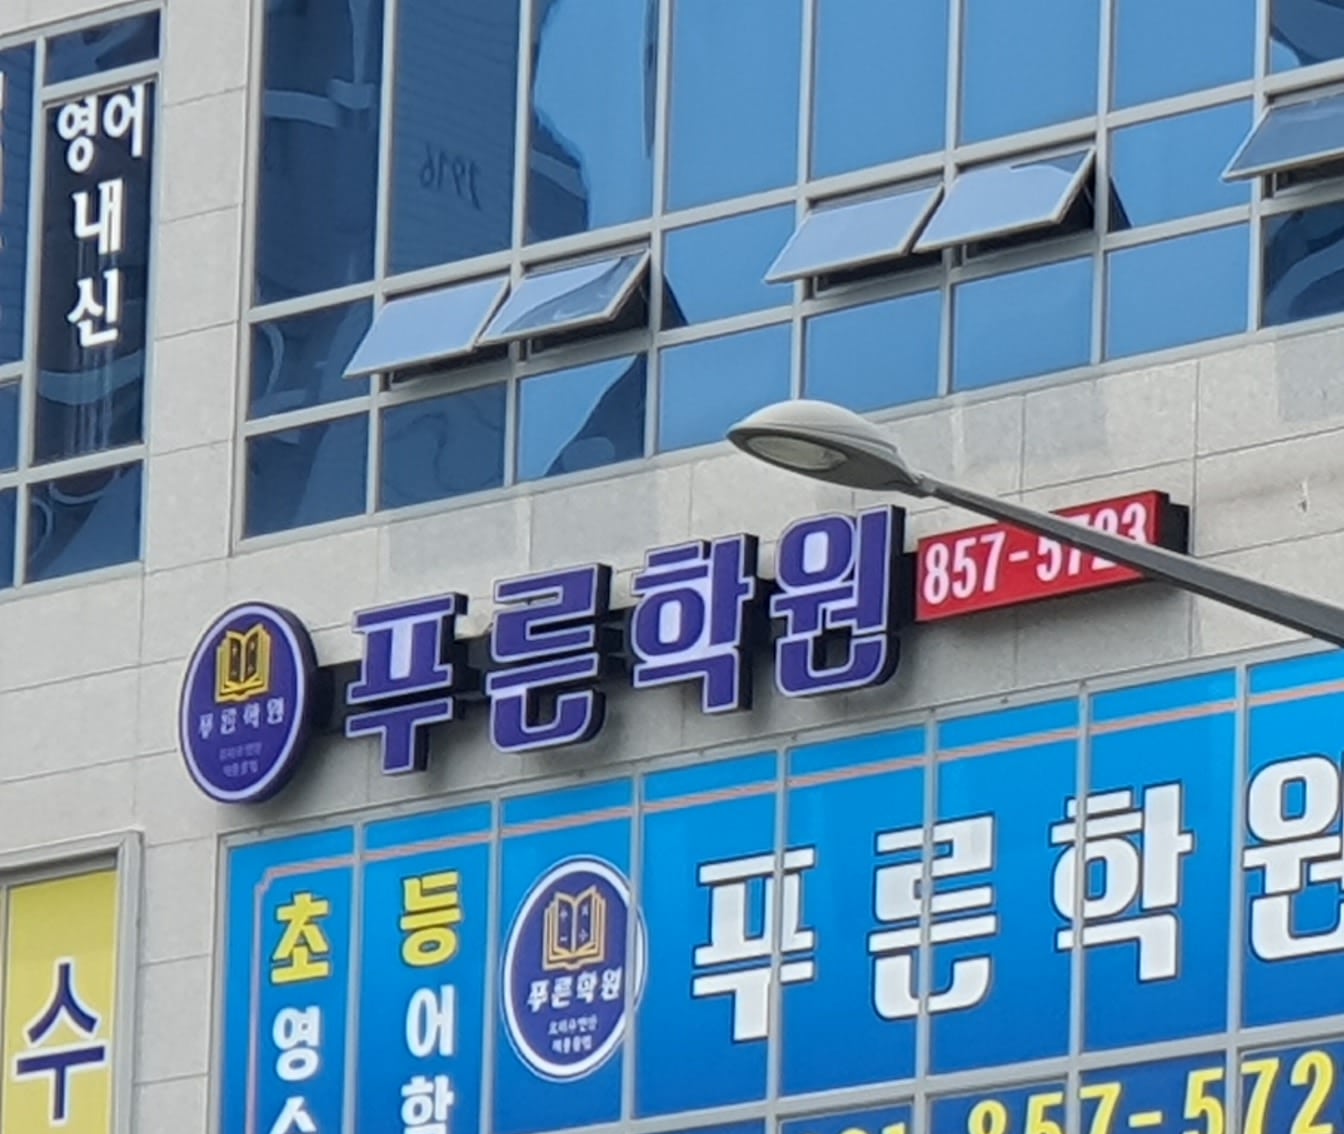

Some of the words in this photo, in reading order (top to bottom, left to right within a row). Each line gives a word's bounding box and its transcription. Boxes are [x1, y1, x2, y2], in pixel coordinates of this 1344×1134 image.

[57, 82, 146, 173] 영어
[67, 177, 124, 348] 내신
[345, 505, 902, 772] 푸른학원
[526, 966, 623, 1014] 푸른학원
